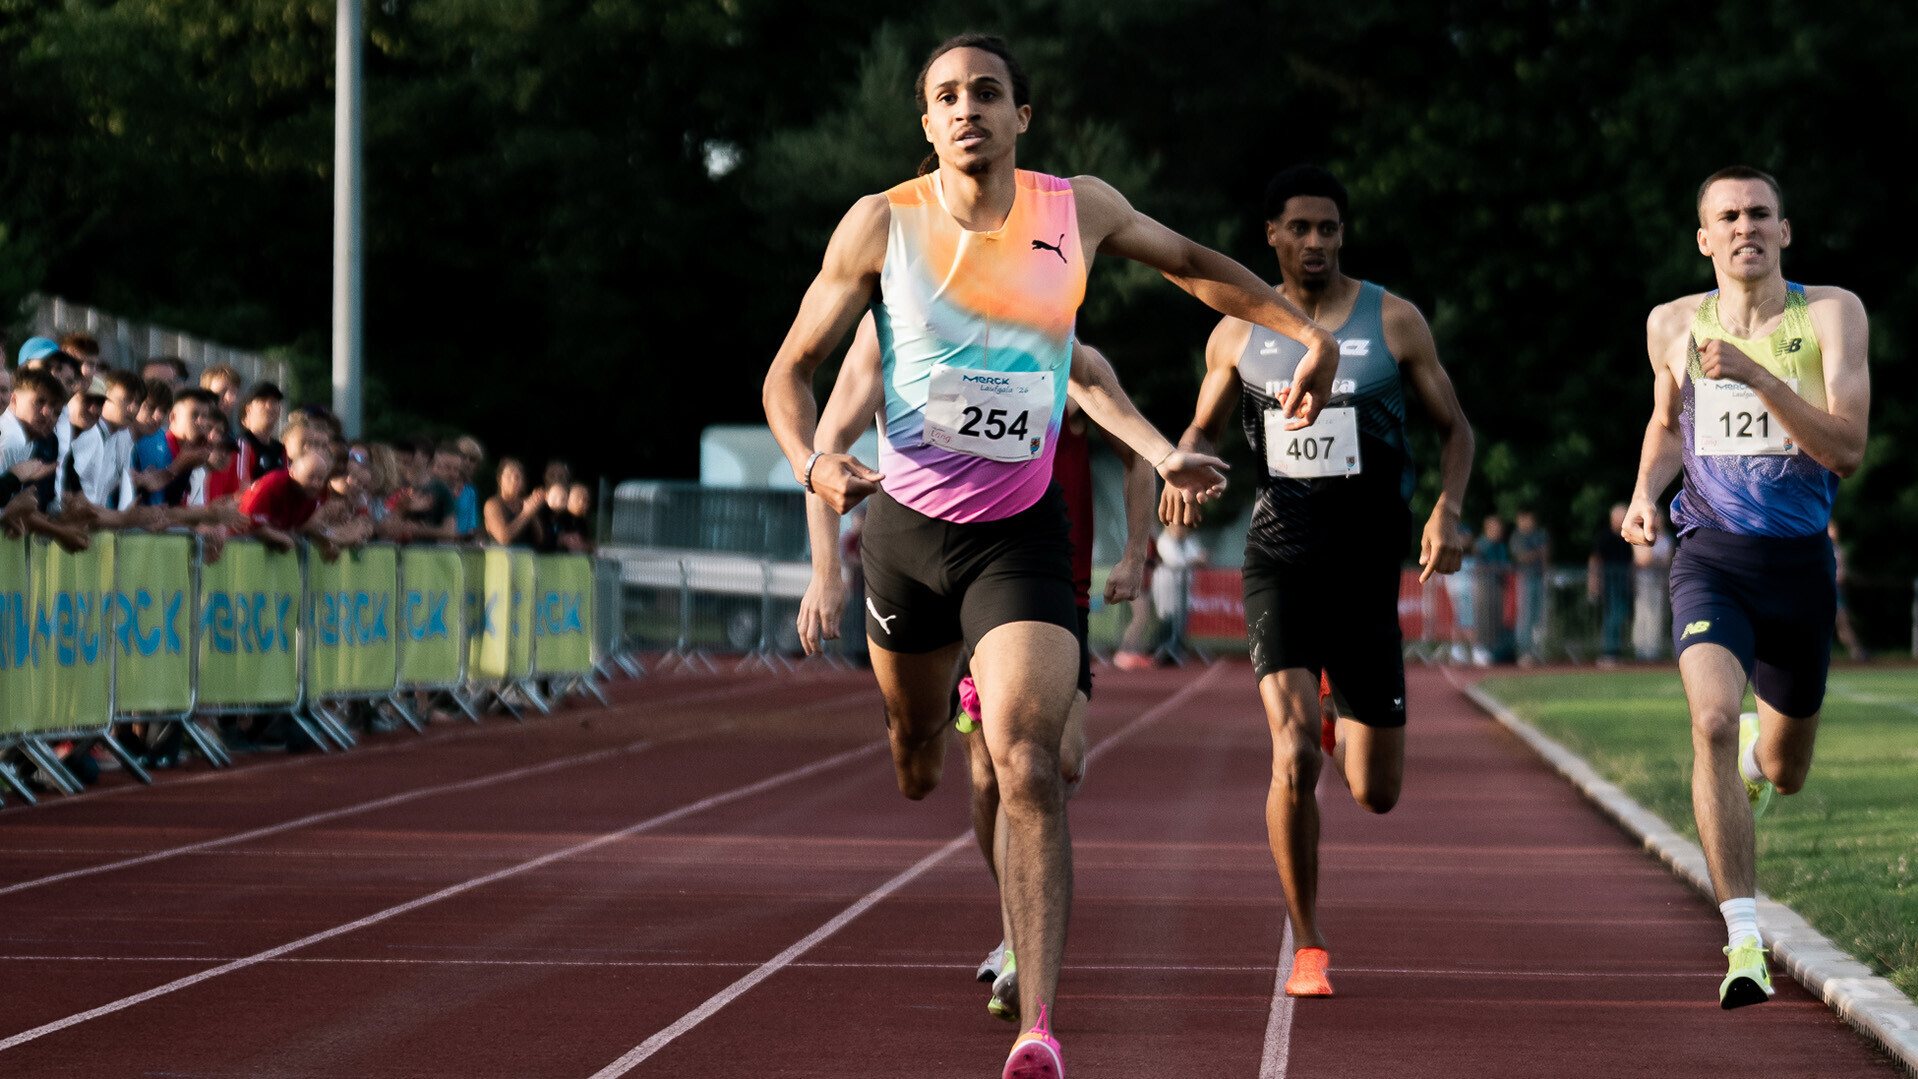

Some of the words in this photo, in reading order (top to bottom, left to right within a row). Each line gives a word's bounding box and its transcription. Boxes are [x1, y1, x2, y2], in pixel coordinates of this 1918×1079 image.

[980, 384, 1013, 395] Laufgala
[957, 405, 1030, 442] 254
[1718, 410, 1769, 438] 121
[1286, 436, 1335, 461] 407
